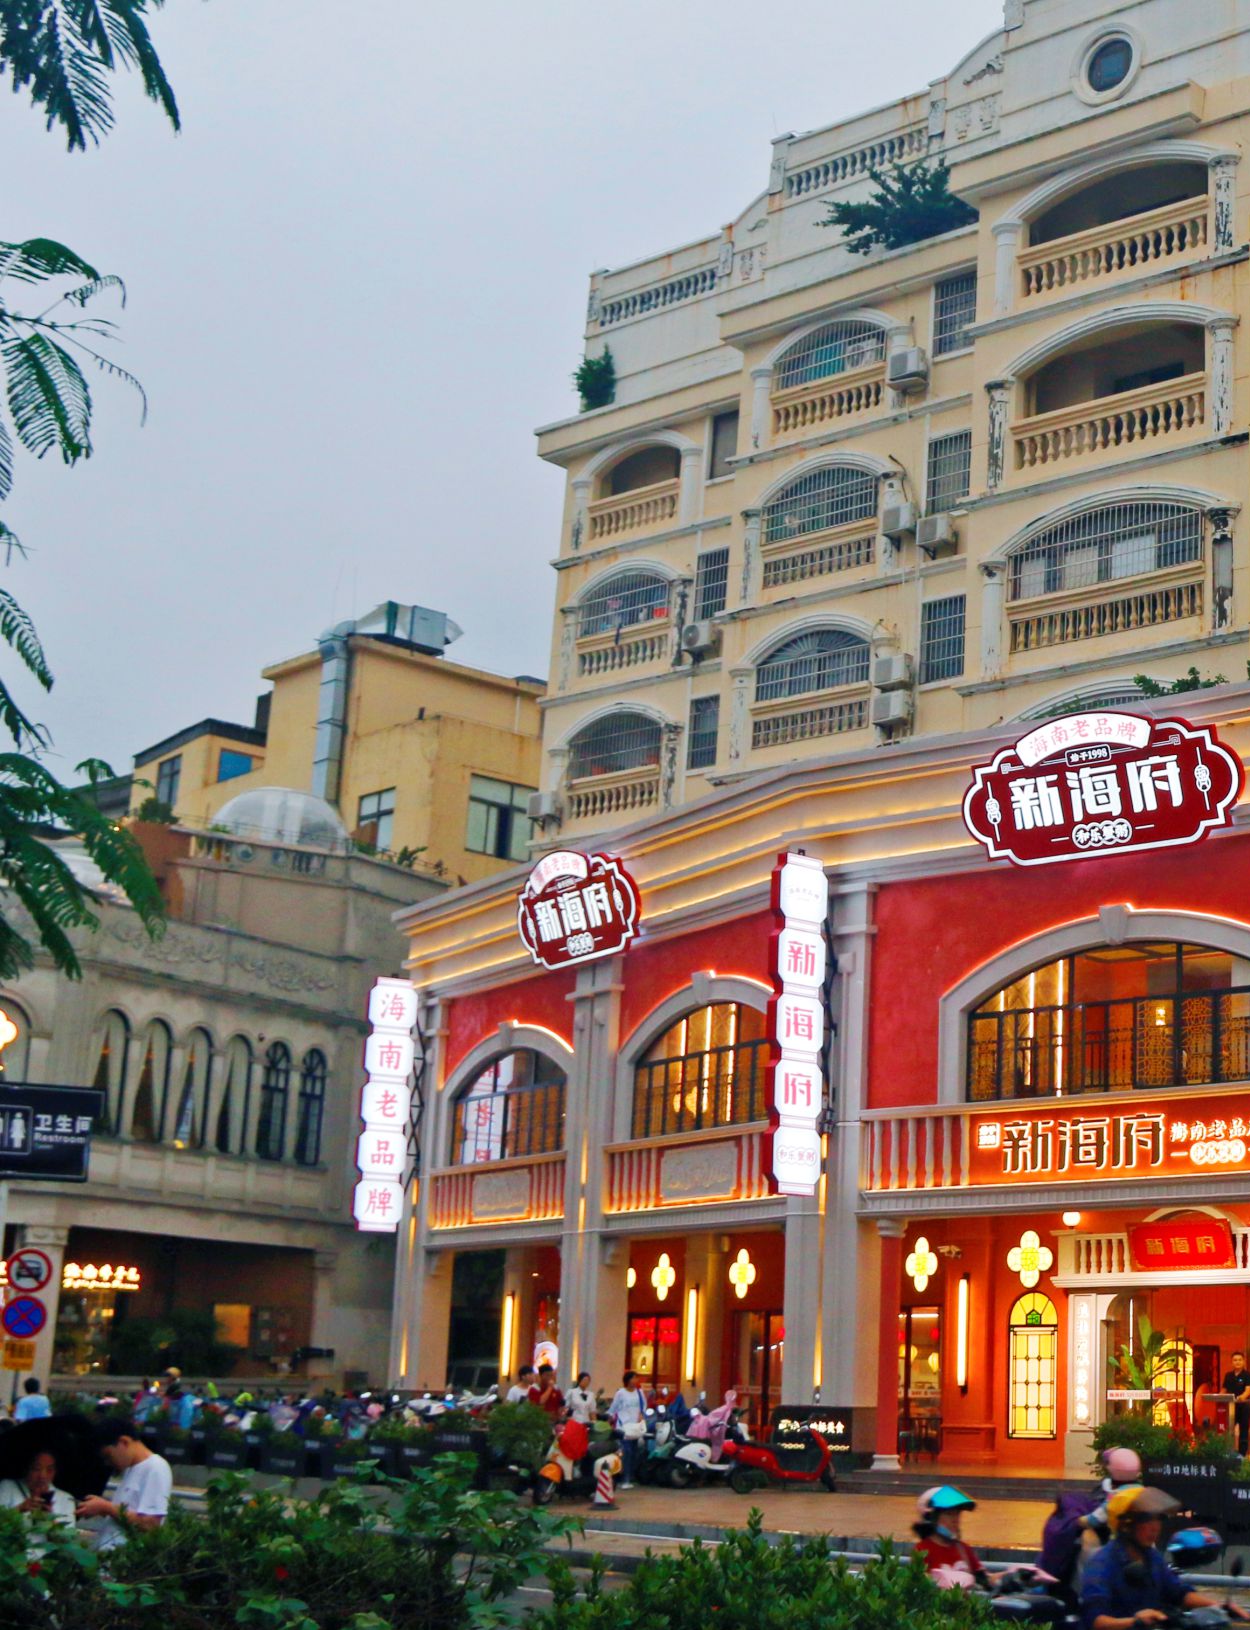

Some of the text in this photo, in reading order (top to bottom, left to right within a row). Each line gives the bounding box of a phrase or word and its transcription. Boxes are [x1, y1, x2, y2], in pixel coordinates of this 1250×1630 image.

[1030, 717, 1137, 758] 海南老品牌
[1009, 754, 1184, 831] 新海府
[534, 882, 613, 942] 新海府
[783, 940, 817, 1107] 新海府
[34, 1113, 93, 1133] 卫生间
[364, 992, 407, 1217] 海南老品牌
[1002, 1112, 1166, 1174] 新海府
